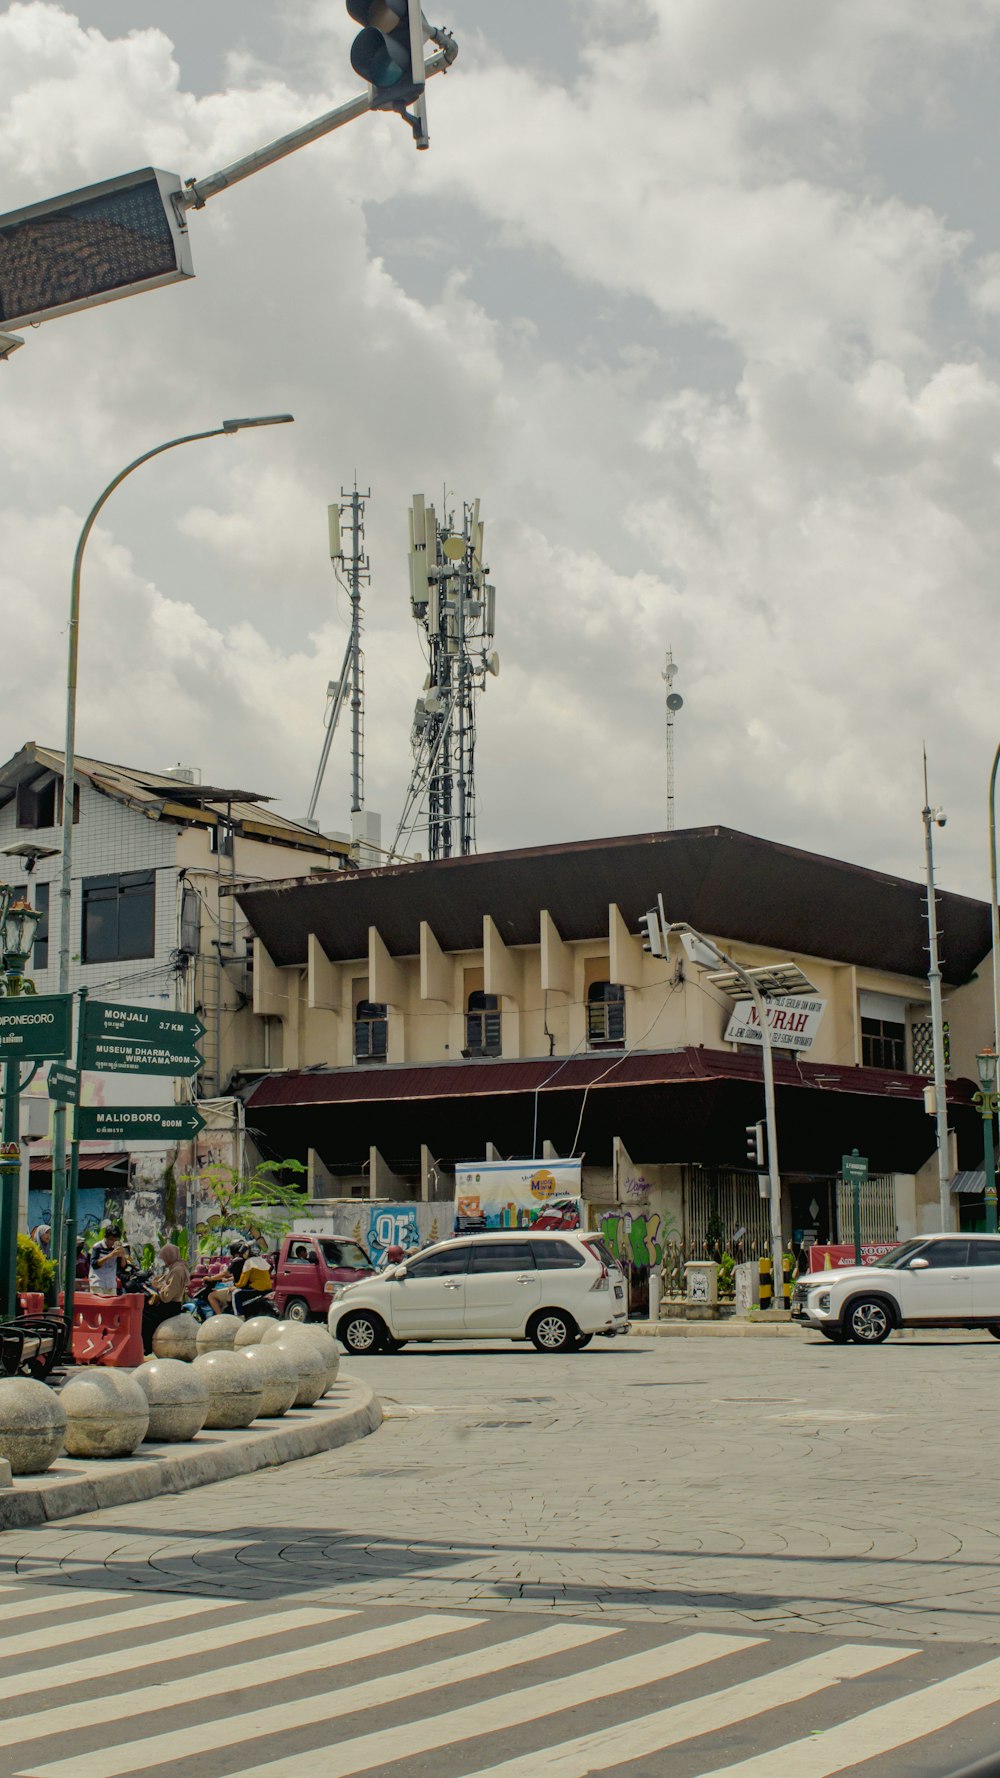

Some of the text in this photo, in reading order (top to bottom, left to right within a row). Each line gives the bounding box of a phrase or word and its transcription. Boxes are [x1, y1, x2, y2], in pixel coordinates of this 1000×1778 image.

[0, 1013, 55, 1026] IPONEGORO
[104, 1009, 149, 1023] MONJALI
[159, 1022, 184, 1032] 3.7 KM
[96, 1045, 171, 1057] MUSEUM DHARMA
[125, 1055, 171, 1065] WIRATAMA
[96, 1113, 161, 1122] MALIOBORO
[161, 1119, 182, 1127] 800M
